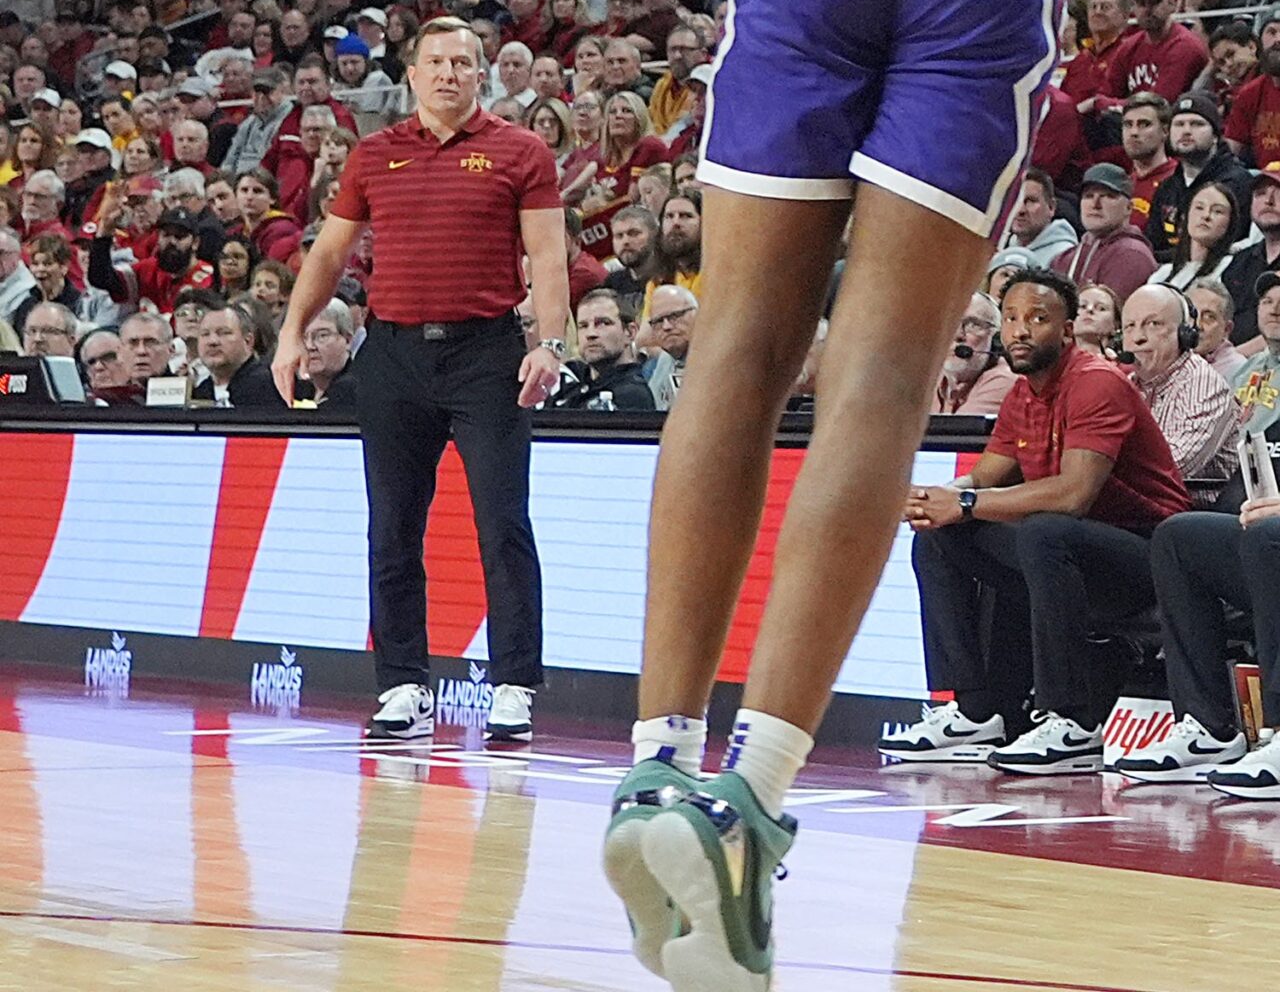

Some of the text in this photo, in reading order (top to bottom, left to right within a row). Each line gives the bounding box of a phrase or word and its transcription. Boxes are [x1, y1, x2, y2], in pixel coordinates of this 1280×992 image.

[85, 647, 132, 674] LANDUS
[252, 662, 303, 690] LANDUS
[437, 678, 495, 708] LANDUS
